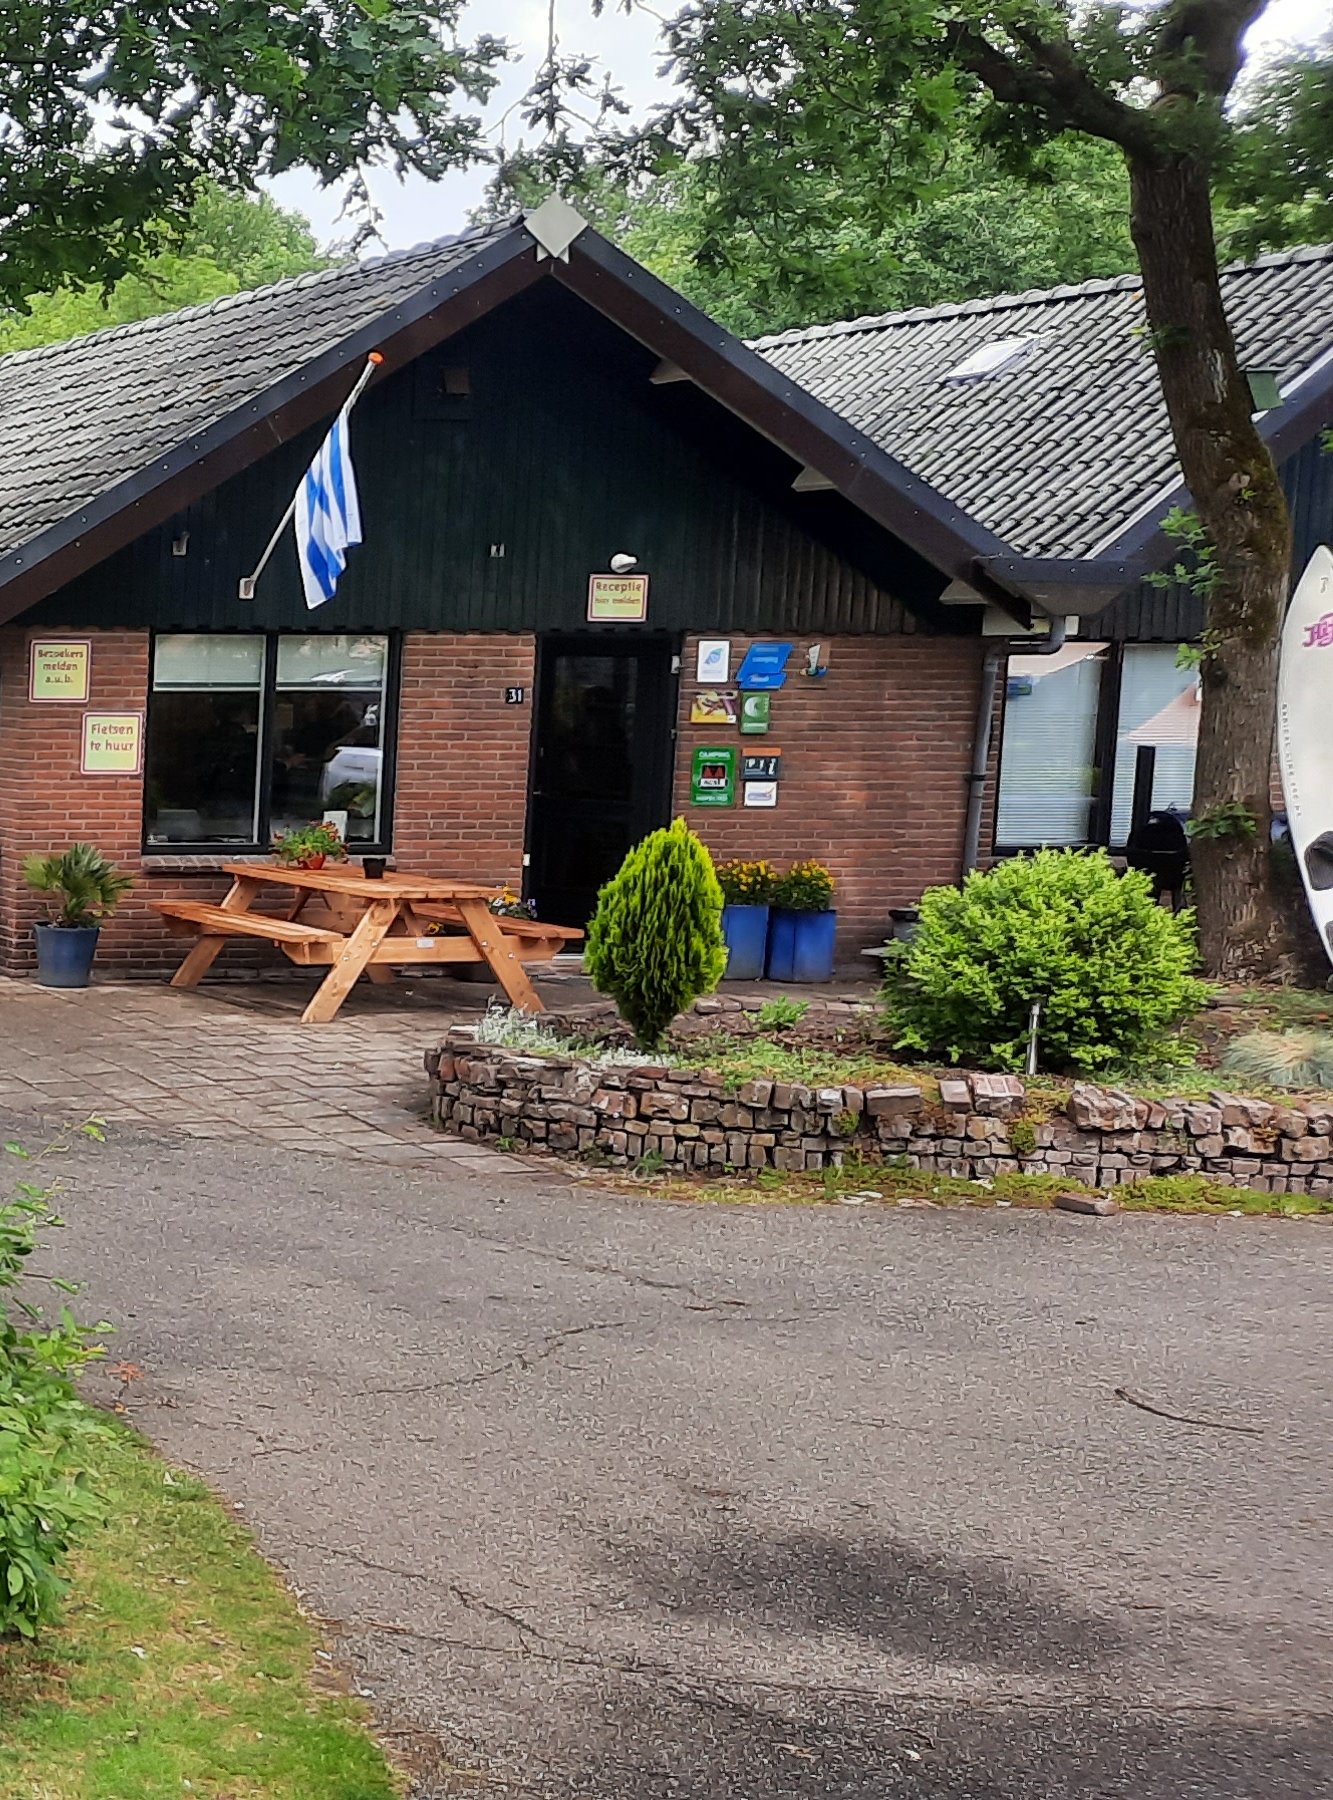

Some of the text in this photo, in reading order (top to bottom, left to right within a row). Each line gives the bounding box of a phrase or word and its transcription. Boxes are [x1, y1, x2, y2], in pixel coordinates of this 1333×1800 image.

[595, 581, 642, 595] Receptie
[37, 647, 84, 659] Bezoekers
[42, 661, 78, 671] melden
[44, 673, 74, 684] a.u.b.
[508, 688, 523, 703] 31
[91, 723, 134, 735] Fietsen
[90, 739, 134, 751] te huur
